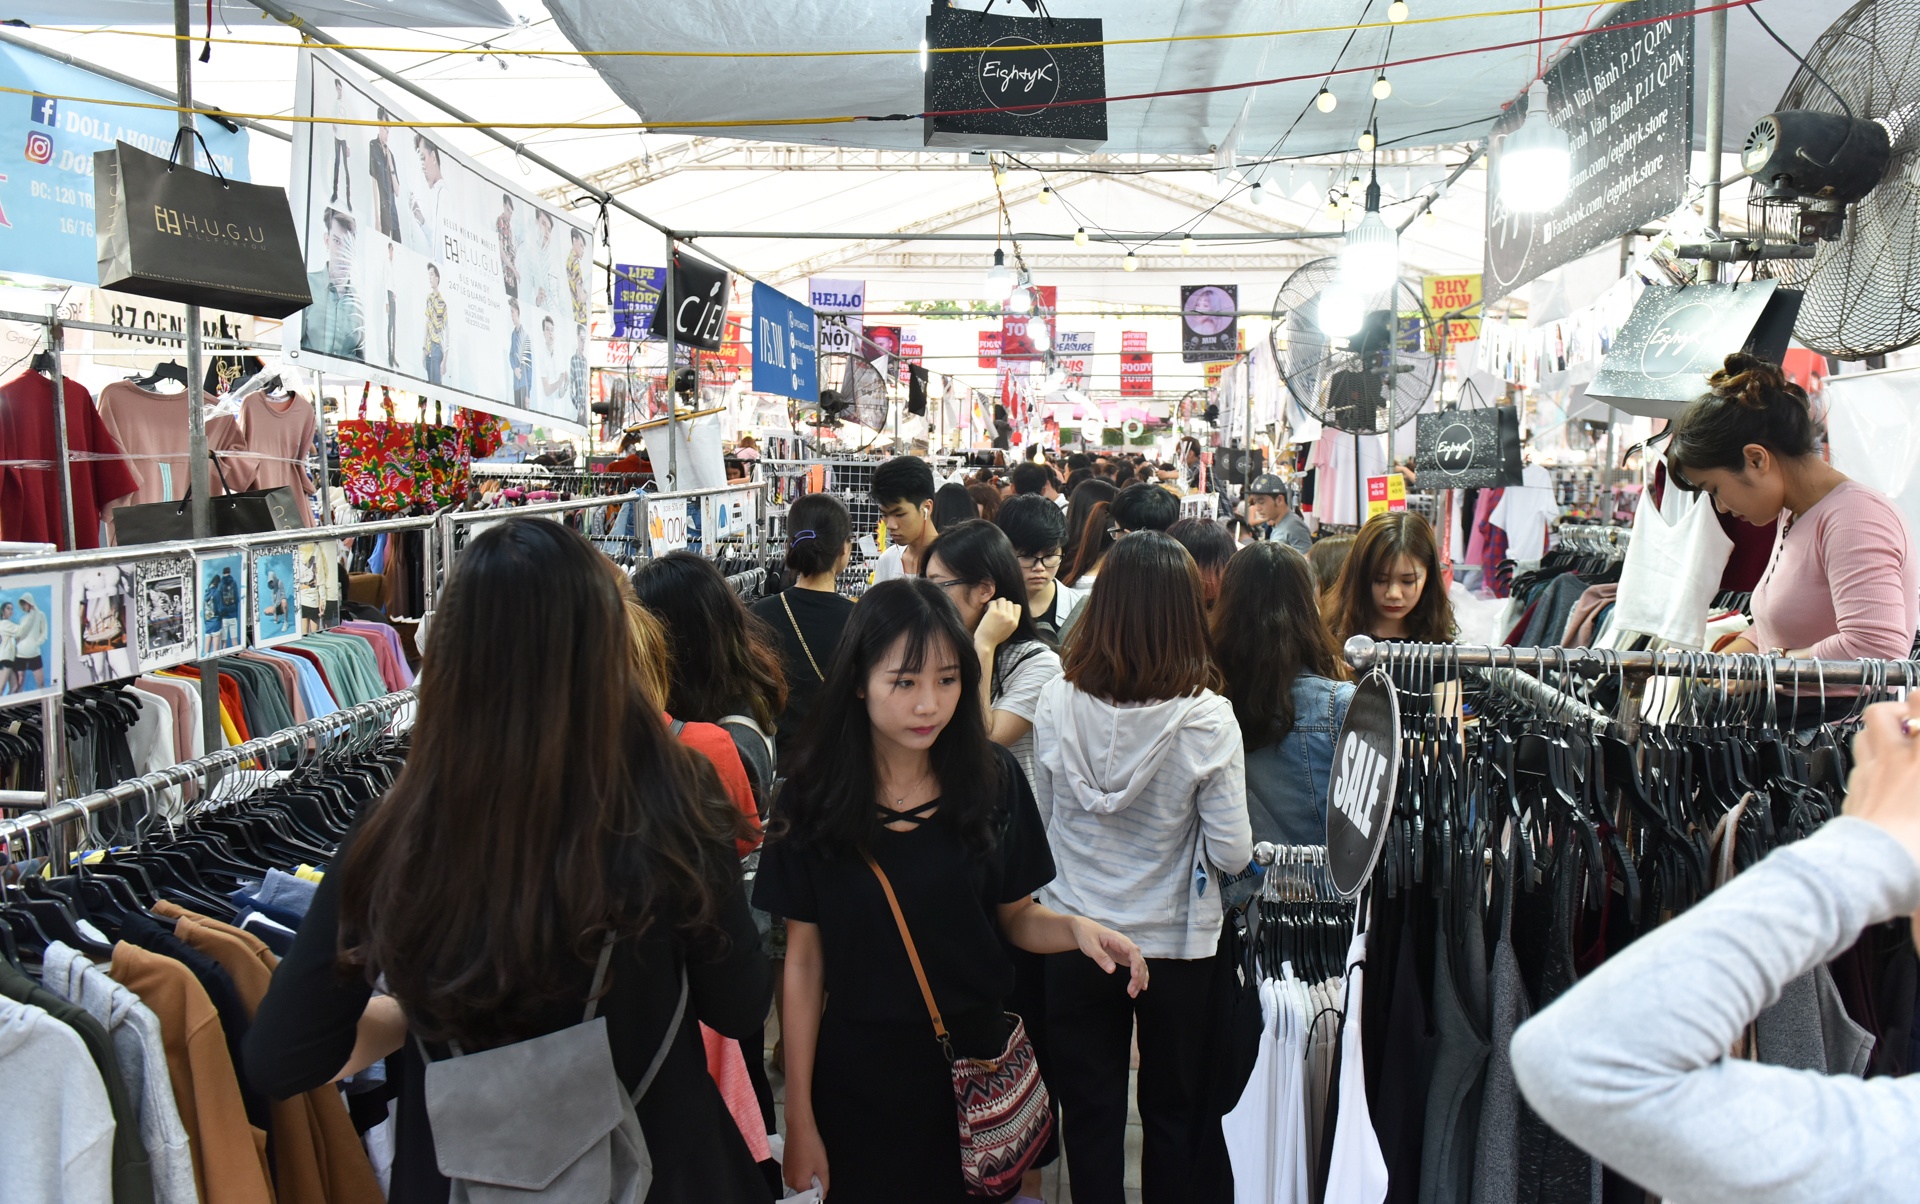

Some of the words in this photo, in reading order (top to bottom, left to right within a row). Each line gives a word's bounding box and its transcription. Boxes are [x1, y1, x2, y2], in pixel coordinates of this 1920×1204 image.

[1573, 87, 1594, 110] Văn
[1593, 62, 1620, 96] Bánh
[1620, 41, 1643, 75] P.17
[1643, 19, 1673, 57] Q.PN
[1589, 115, 1608, 138] Văn
[1609, 92, 1634, 125] Bánh
[1635, 72, 1655, 105] P.11
[1656, 46, 1685, 87] Q.PN
[55, 185, 76, 205] 120
[182, 212, 265, 244] H.U.G.U
[628, 266, 655, 280] LIFE
[1434, 279, 1470, 294] BUY
[811, 291, 862, 308] HELLO
[1431, 294, 1473, 309] NOW
[821, 328, 850, 350] NỘI
[1061, 333, 1079, 342] THE
[1121, 363, 1153, 372] FOODY
[1333, 730, 1388, 840] SALE
